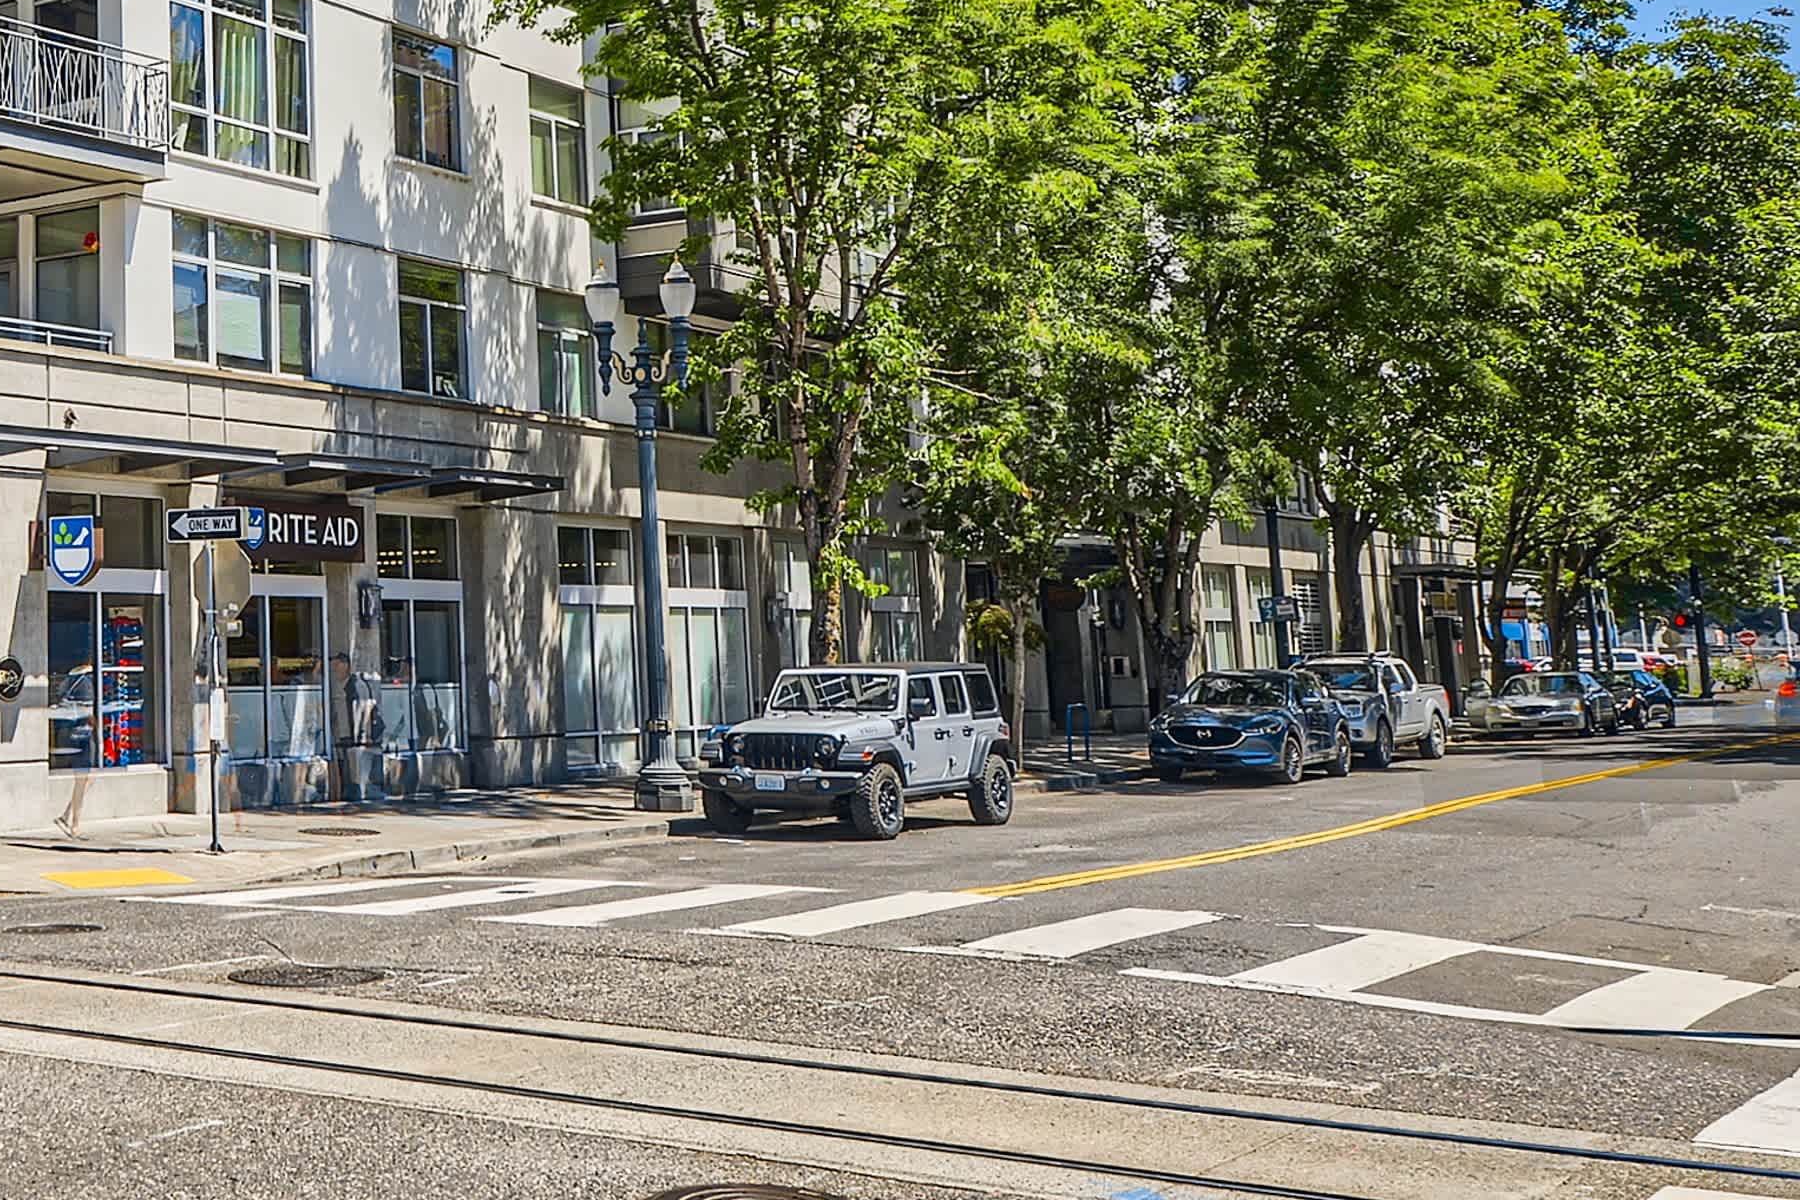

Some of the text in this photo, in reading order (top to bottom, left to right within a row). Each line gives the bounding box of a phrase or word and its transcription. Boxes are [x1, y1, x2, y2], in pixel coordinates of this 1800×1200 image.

[188, 517, 234, 531] ONE WAY
[268, 512, 359, 547] RITE AID
